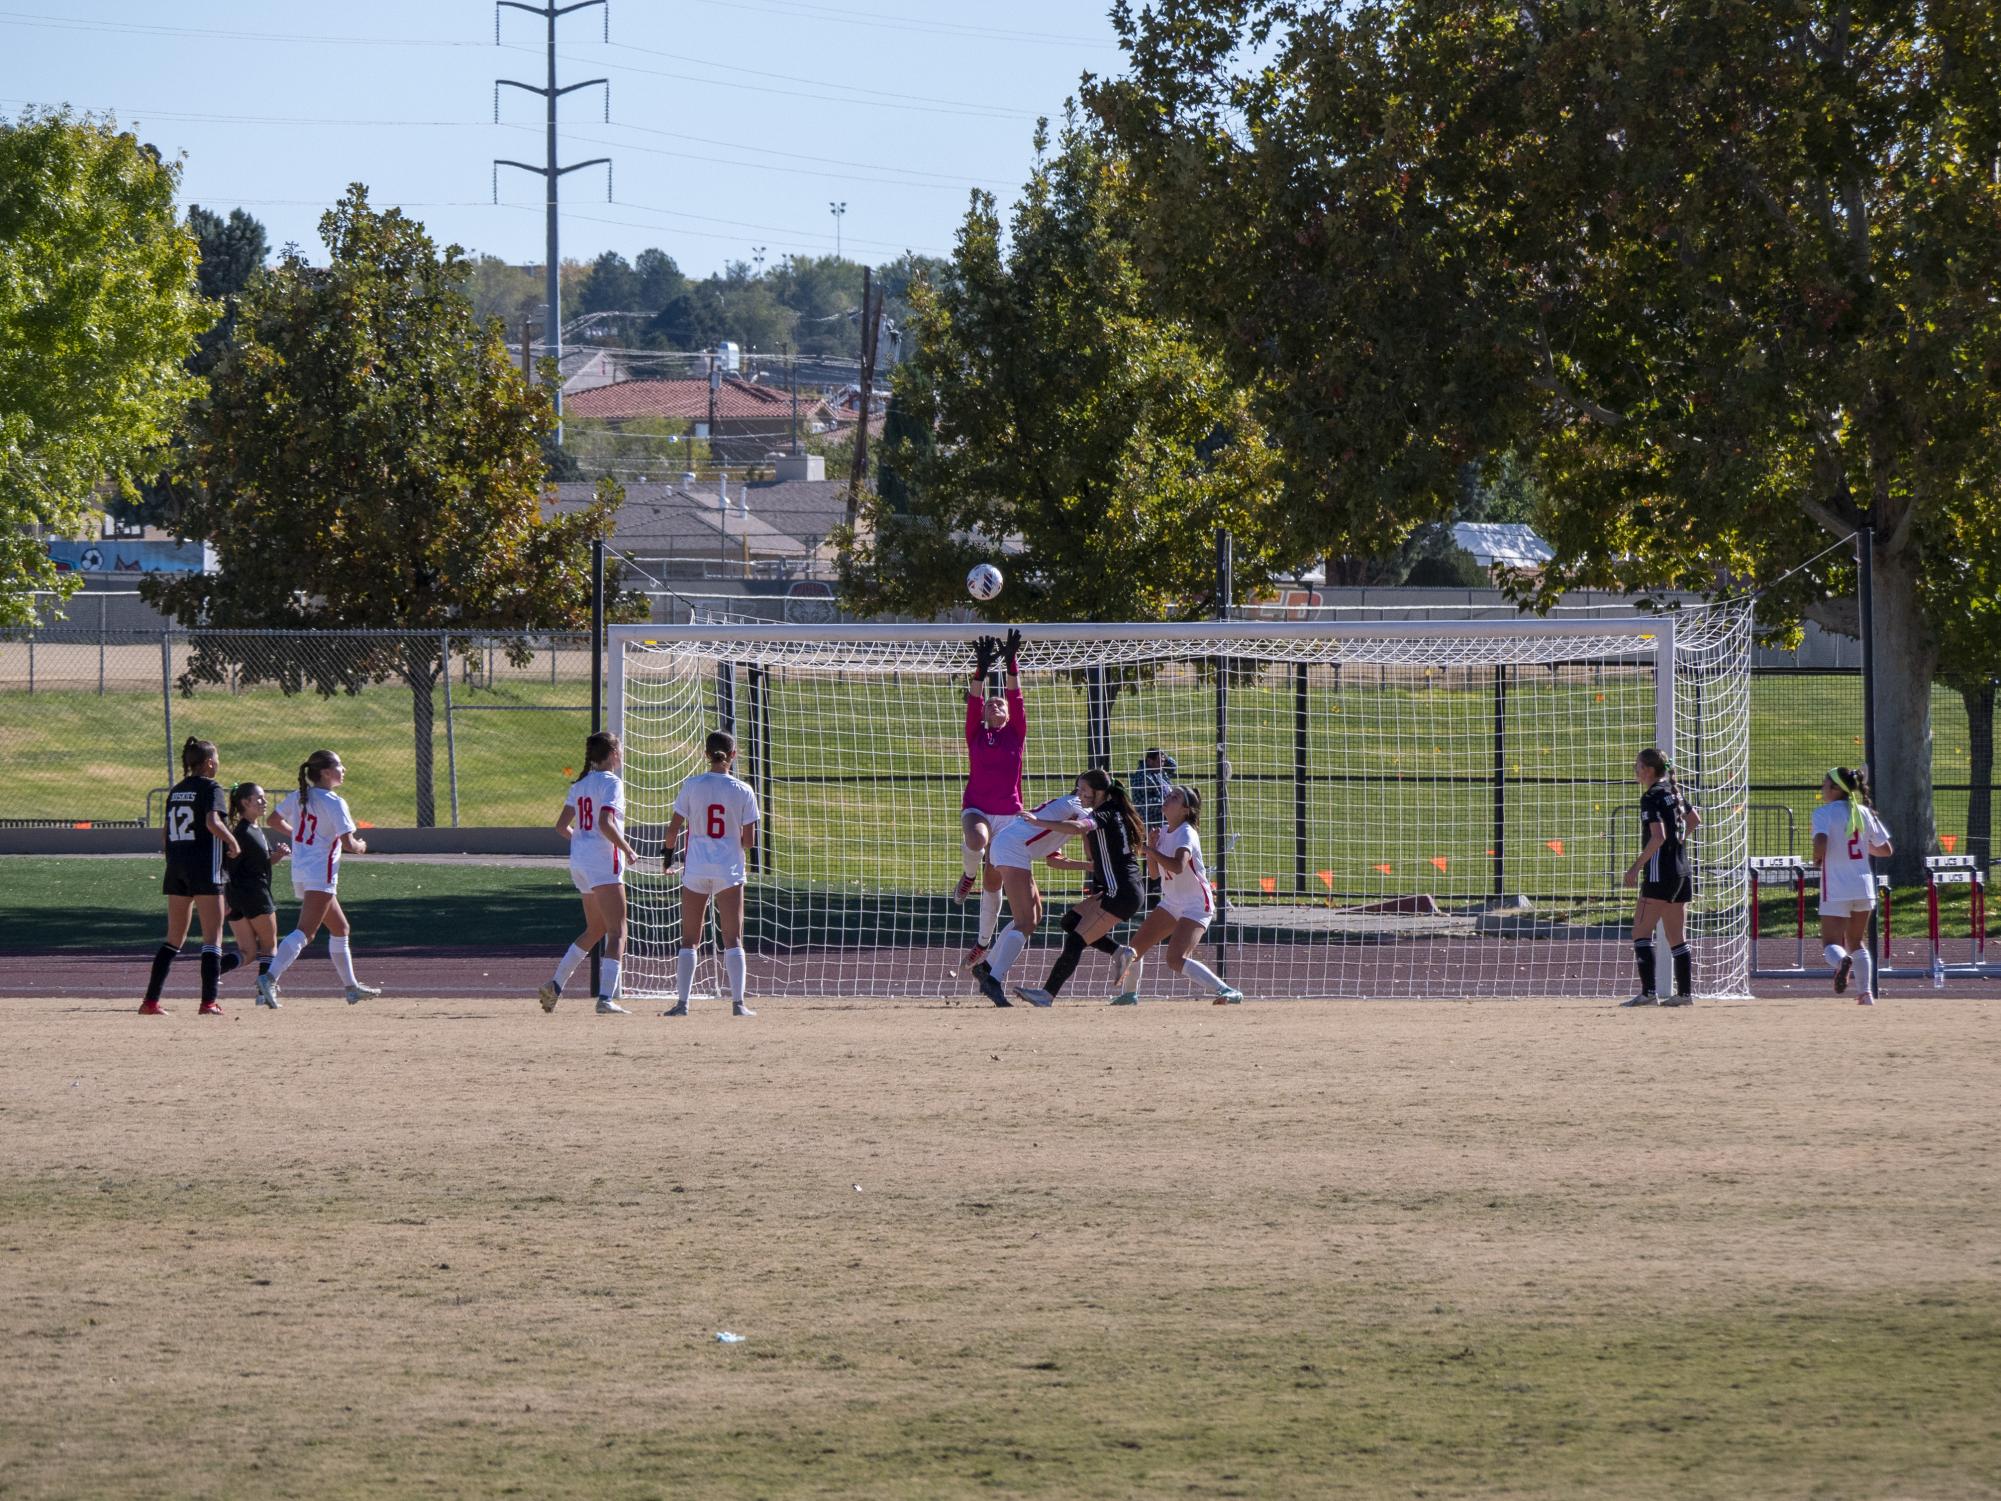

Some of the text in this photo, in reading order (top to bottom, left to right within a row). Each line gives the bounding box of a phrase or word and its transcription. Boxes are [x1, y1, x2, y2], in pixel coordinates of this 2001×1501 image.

[167, 806, 196, 842] 12
[294, 808, 318, 846] 17
[577, 796, 594, 831] 18
[706, 803, 726, 839] 6
[1847, 827, 1864, 860] 2
